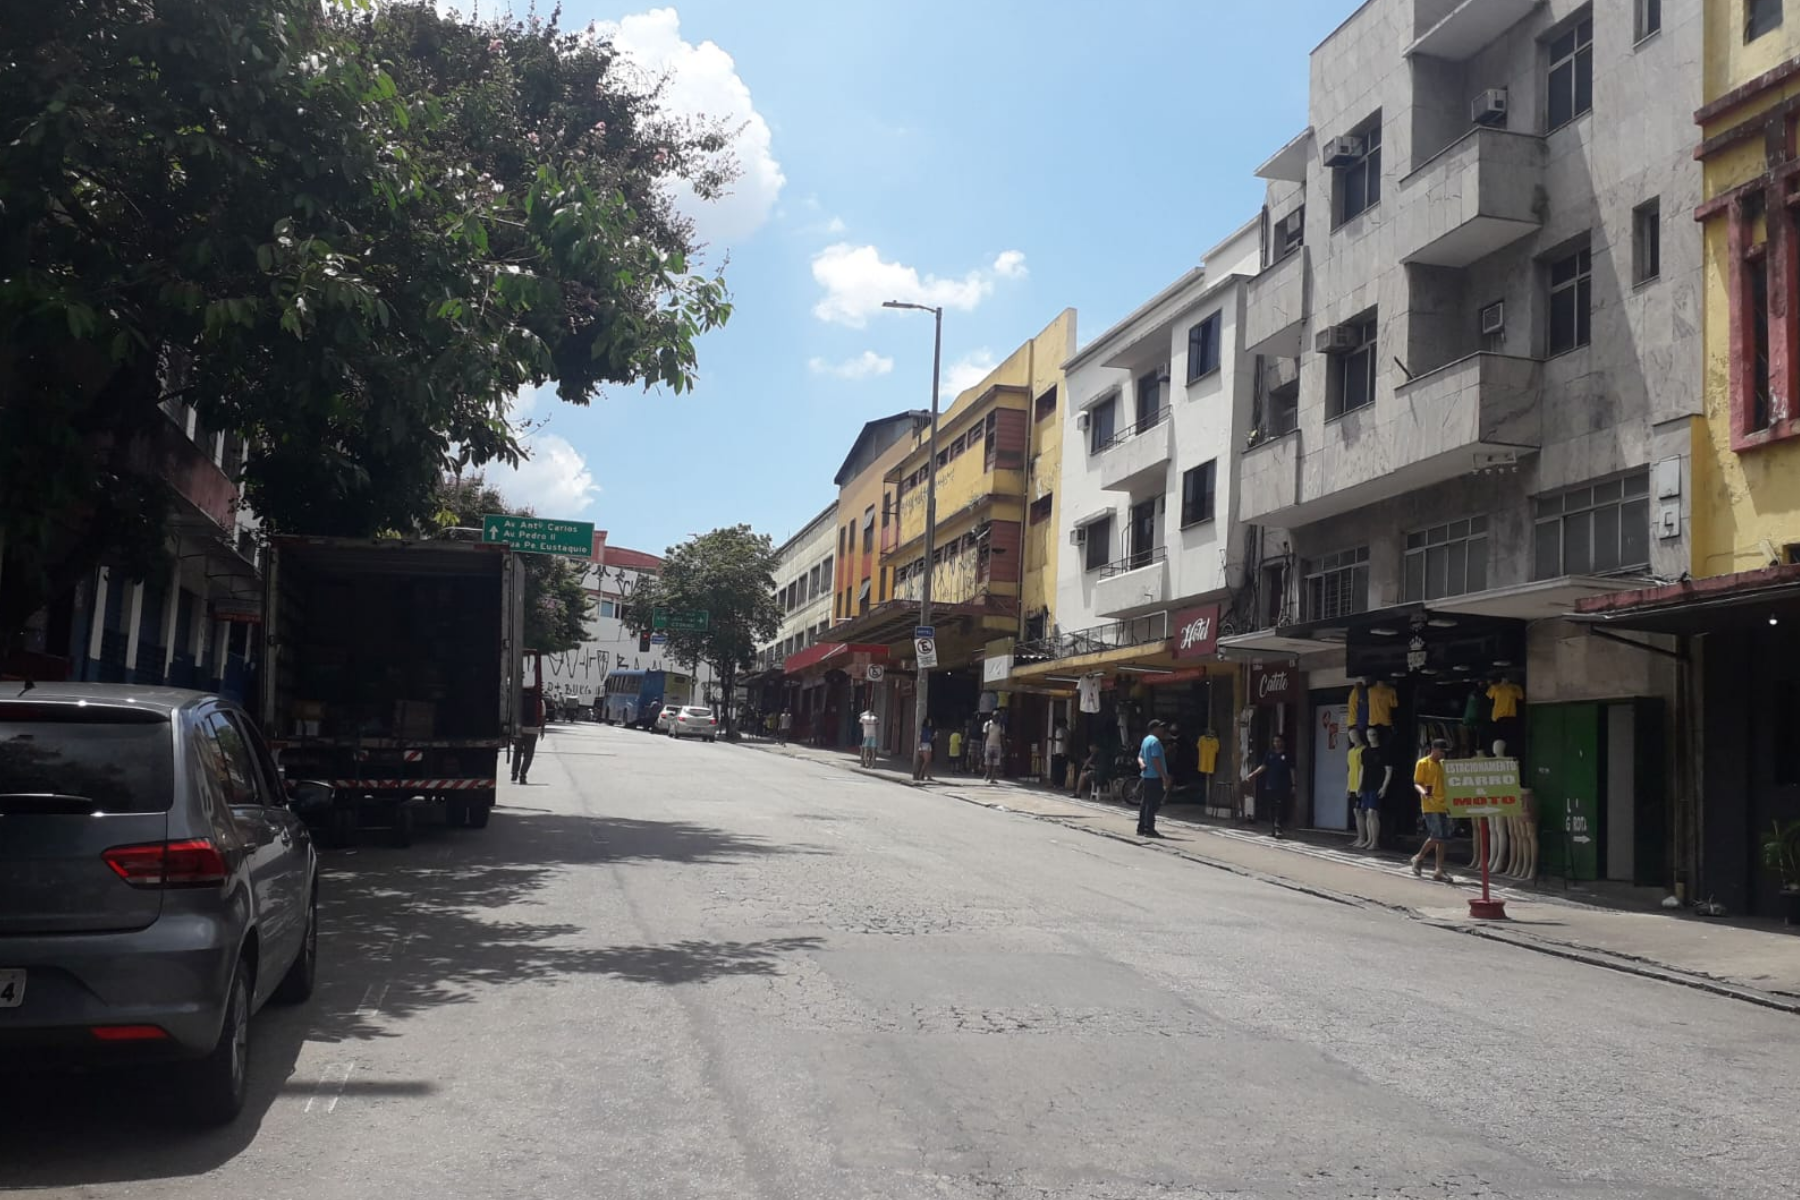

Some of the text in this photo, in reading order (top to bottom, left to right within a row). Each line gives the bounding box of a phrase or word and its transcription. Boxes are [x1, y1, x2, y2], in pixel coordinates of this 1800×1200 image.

[547, 523, 578, 533] Carlos
[518, 530, 547, 540] Pedro
[523, 540, 536, 549] Pe
[1180, 617, 1211, 649] Hotel
[1445, 760, 1517, 774] ESTACIONAMENTO
[1448, 774, 1516, 787] CARRO
[1453, 795, 1516, 807] MOTO
